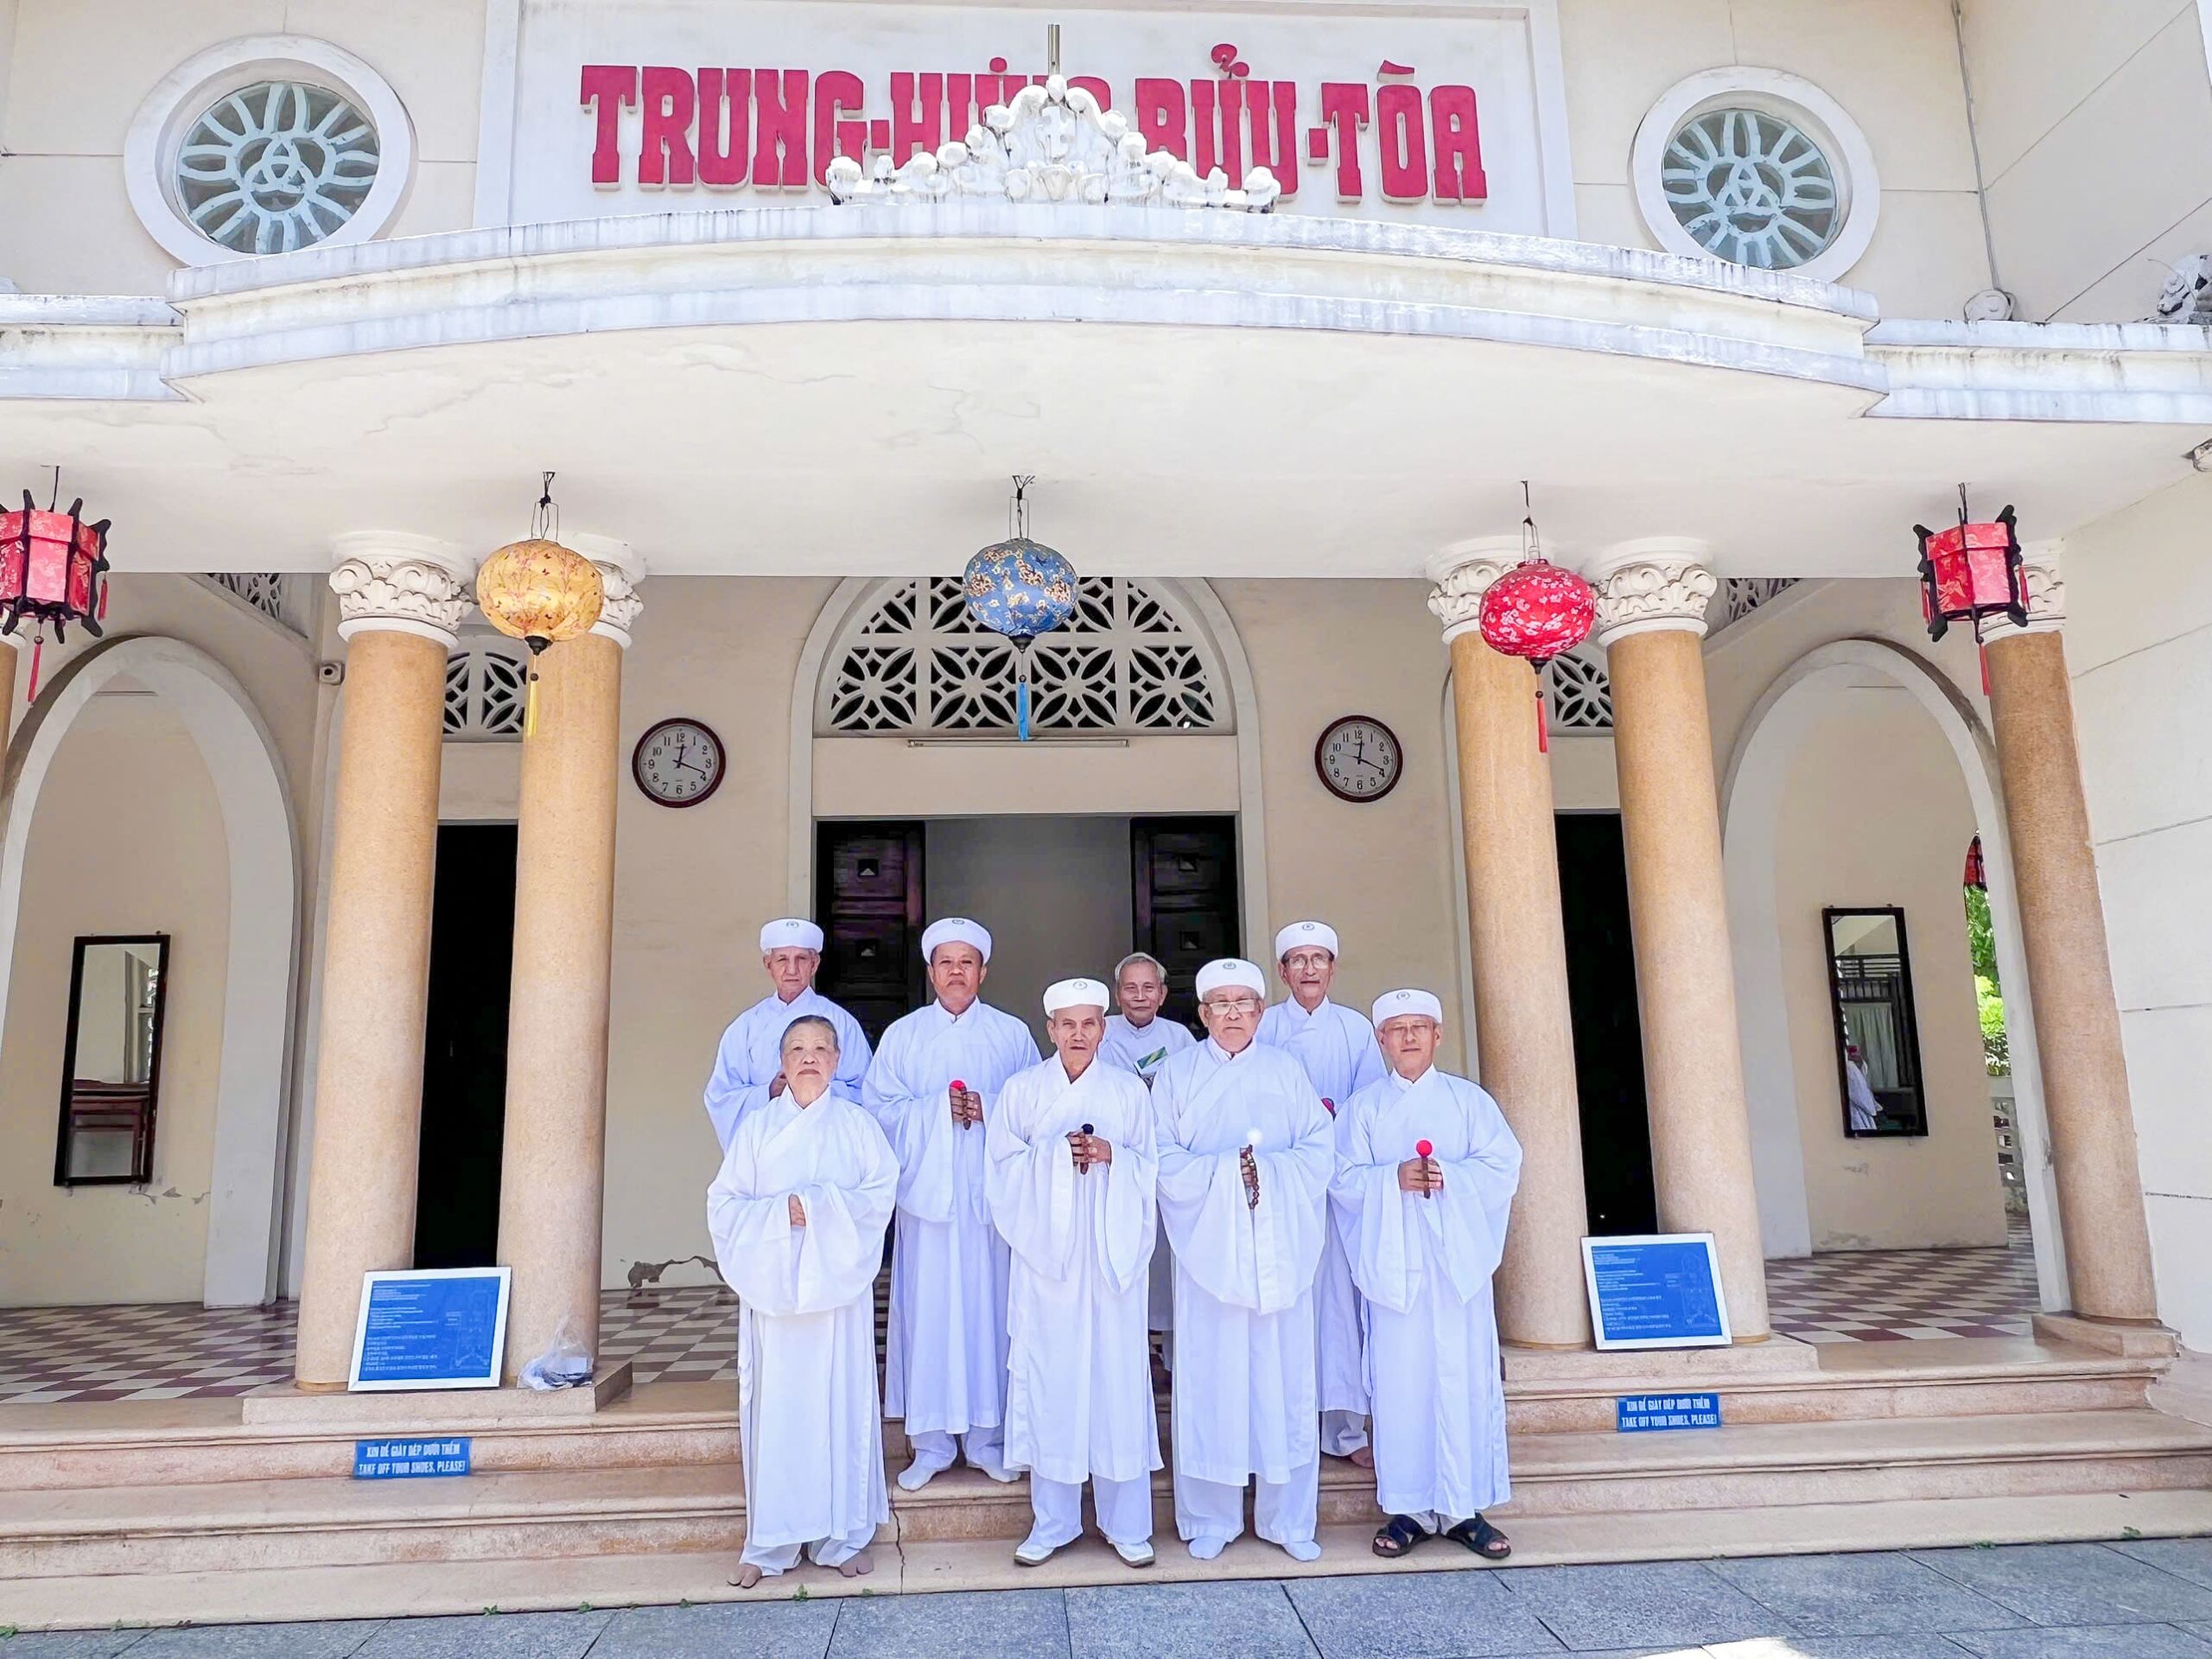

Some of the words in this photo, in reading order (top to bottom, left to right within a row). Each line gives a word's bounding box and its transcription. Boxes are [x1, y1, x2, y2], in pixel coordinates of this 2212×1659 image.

[1622, 1417, 1637, 1427] TAKE
[1638, 1416, 1649, 1427] OFF
[1650, 1415, 1667, 1427] YOUR
[1691, 1414, 1717, 1425] PLEASE!
[359, 1464, 376, 1475] TAKE
[378, 1463, 390, 1474] OFF
[392, 1462, 410, 1474] YOUR
[437, 1460, 466, 1472] PLEASE!
